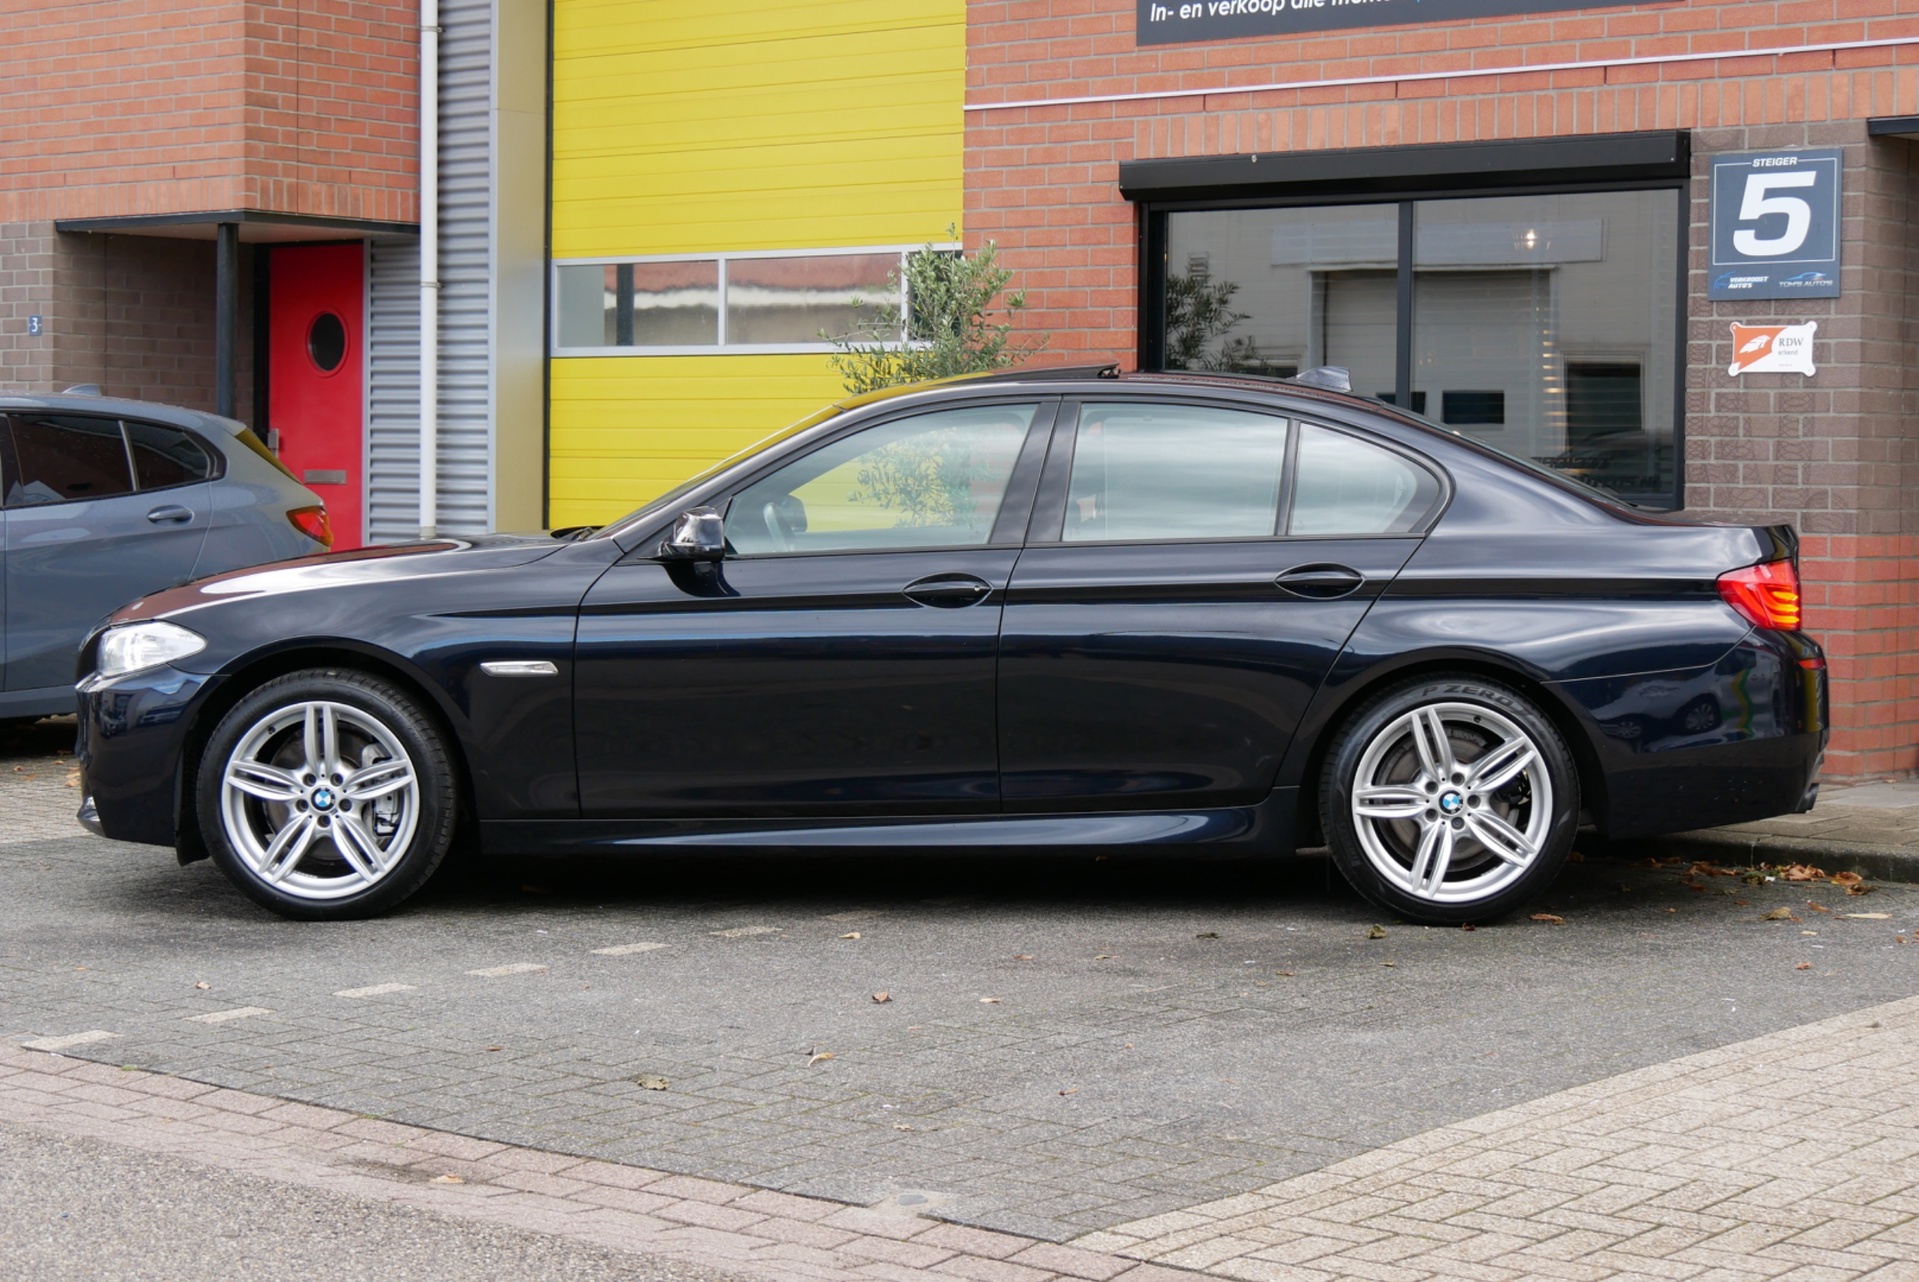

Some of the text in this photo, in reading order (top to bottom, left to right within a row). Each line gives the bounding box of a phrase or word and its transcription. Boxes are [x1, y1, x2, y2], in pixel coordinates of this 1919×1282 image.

[1150, 3, 1174, 22] In-
[1180, 2, 1202, 19] en
[1208, 0, 1285, 16] verkoop
[1752, 156, 1798, 168] STEIGER
[1729, 170, 1817, 256] 5
[31, 317, 38, 332] 3
[1778, 337, 1804, 347] RDW
[1422, 685, 1438, 697] P
